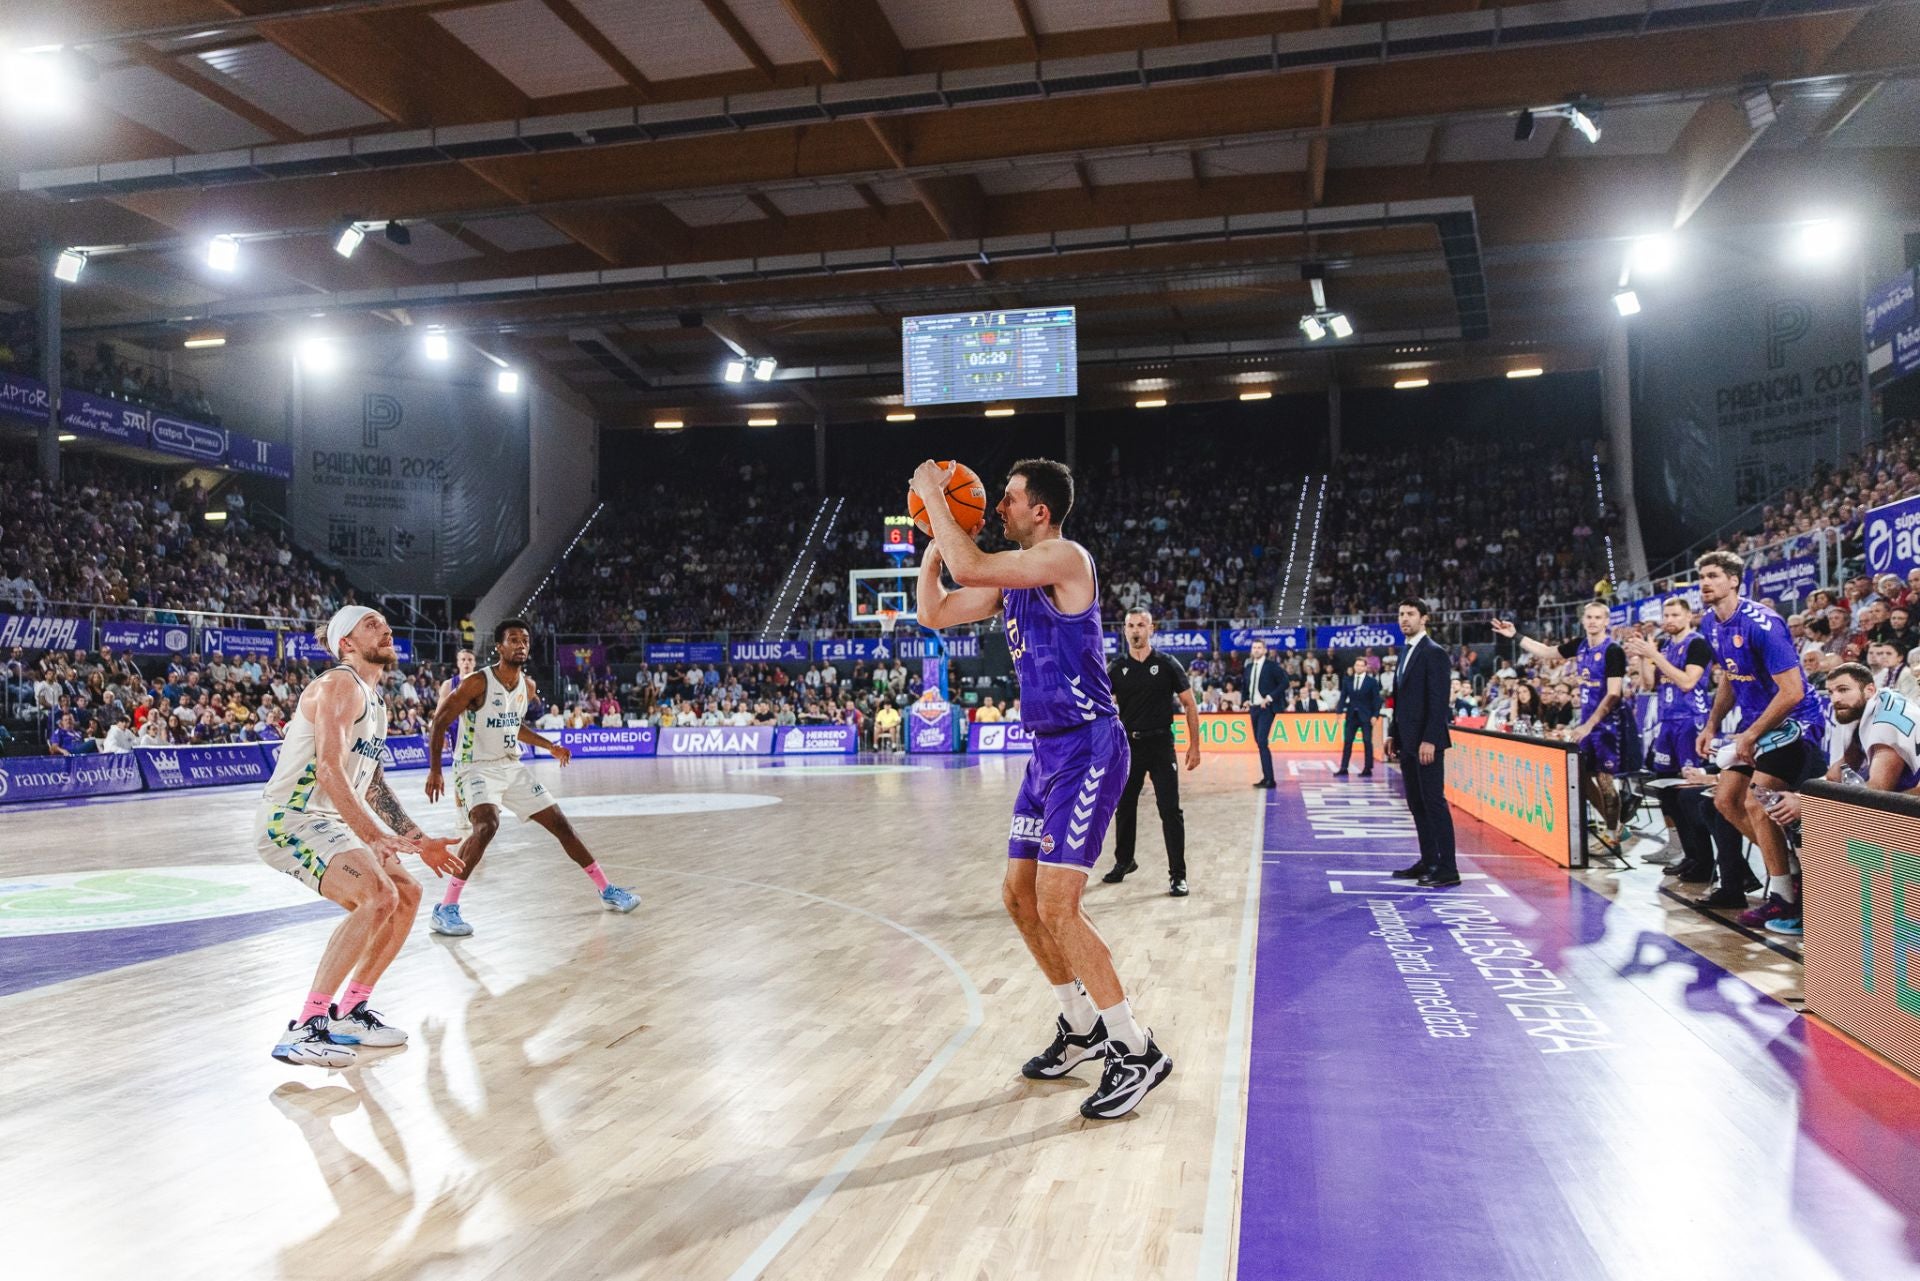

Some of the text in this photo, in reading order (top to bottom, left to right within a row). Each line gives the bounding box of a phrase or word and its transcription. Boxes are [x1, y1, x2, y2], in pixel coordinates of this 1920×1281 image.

[0, 383, 48, 407] APTOR
[313, 450, 392, 477] PALENCIA
[890, 528, 902, 545] 6
[1, 615, 80, 650] ALCOPAL
[1329, 634, 1395, 648] MUNDO
[733, 644, 782, 661] JULUIS
[822, 639, 865, 656] raiz
[1665, 687, 1673, 702] 8
[504, 734, 516, 749] 55
[564, 731, 651, 745] DENTOMEDIC
[672, 731, 760, 752] URMAN
[806, 730, 848, 740] HERRERO
[191, 751, 247, 761] HOTEL
[394, 747, 426, 762] epsilon
[14, 764, 135, 787] ramos ópticos
[190, 763, 261, 779] REY SANCHO
[1386, 944, 1450, 975] Dental
[1425, 897, 1625, 1053] MORALESCERVERA
[1404, 977, 1478, 1038] Inmediata
